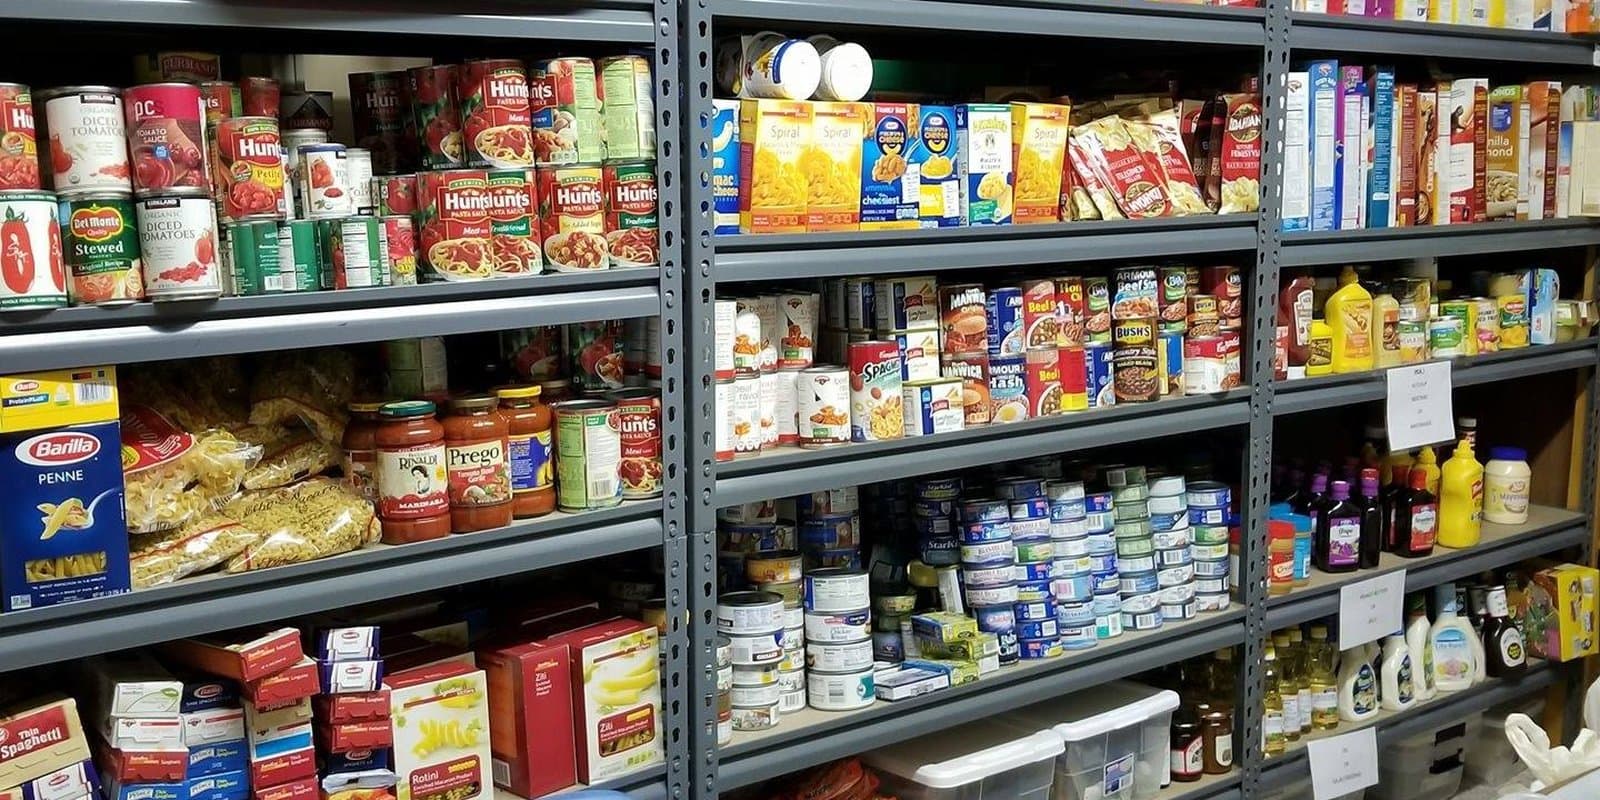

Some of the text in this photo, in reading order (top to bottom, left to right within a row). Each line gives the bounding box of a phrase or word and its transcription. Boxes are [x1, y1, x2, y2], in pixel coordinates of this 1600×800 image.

[771, 125, 800, 139] Spiral
[824, 126, 850, 139] Spiral
[1035, 128, 1058, 140] Spiral
[1488, 135, 1510, 146] nilla
[74, 217, 120, 229] Del Monte
[146, 220, 182, 232] DICED
[141, 229, 196, 241] TOMATOES
[76, 241, 125, 255] Stewed
[1118, 279, 1142, 292] Beef
[622, 416, 656, 432] unt's
[36, 437, 94, 458] Barilla
[399, 455, 437, 470] RINALDI
[450, 447, 499, 468] Prego
[38, 469, 84, 485] PENNE
[928, 540, 958, 549] StarKi
[18, 727, 39, 739] Thin
[1, 728, 62, 758] Spaghetti
[412, 770, 439, 785] Rotini
